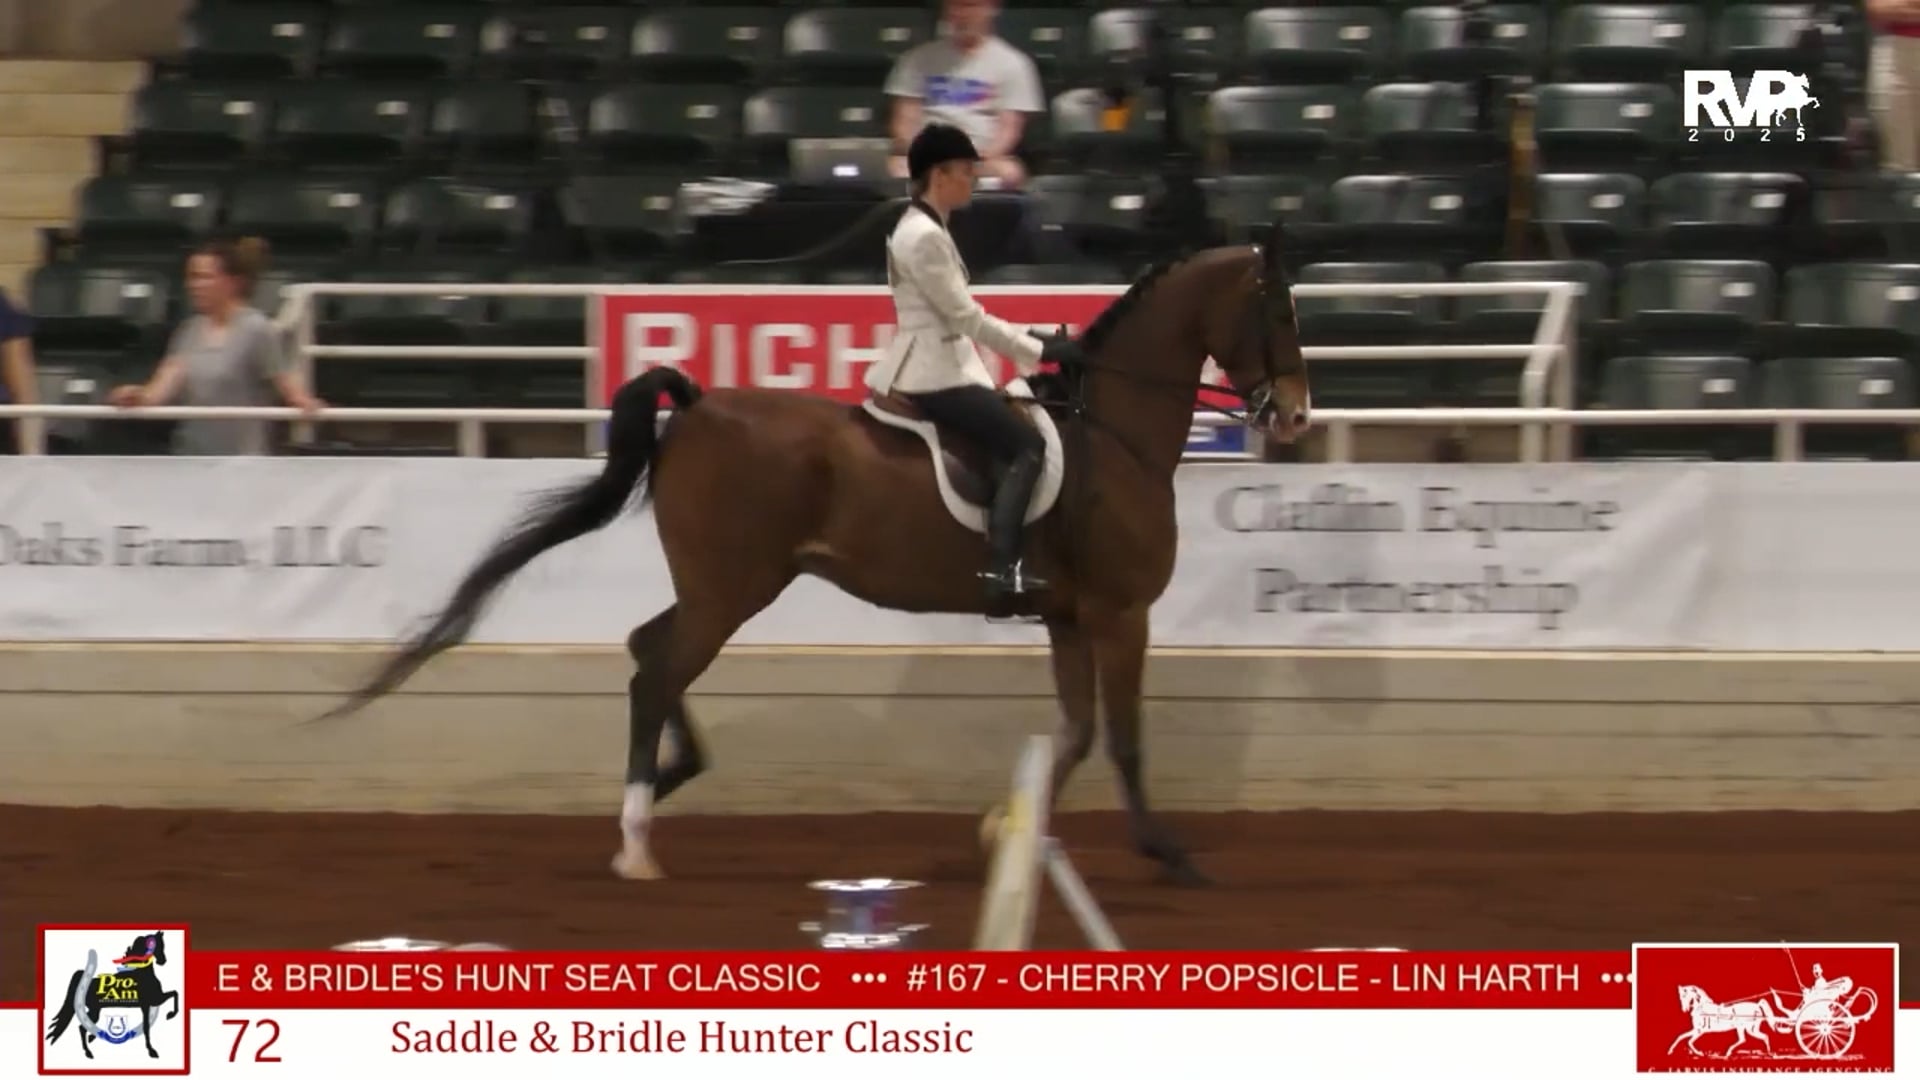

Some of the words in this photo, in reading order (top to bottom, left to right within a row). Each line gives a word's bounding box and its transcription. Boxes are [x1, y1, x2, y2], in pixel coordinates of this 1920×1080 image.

[271, 524, 386, 568] LLC
[1416, 485, 1621, 549] Equine
[1253, 564, 1579, 630] Partnership
